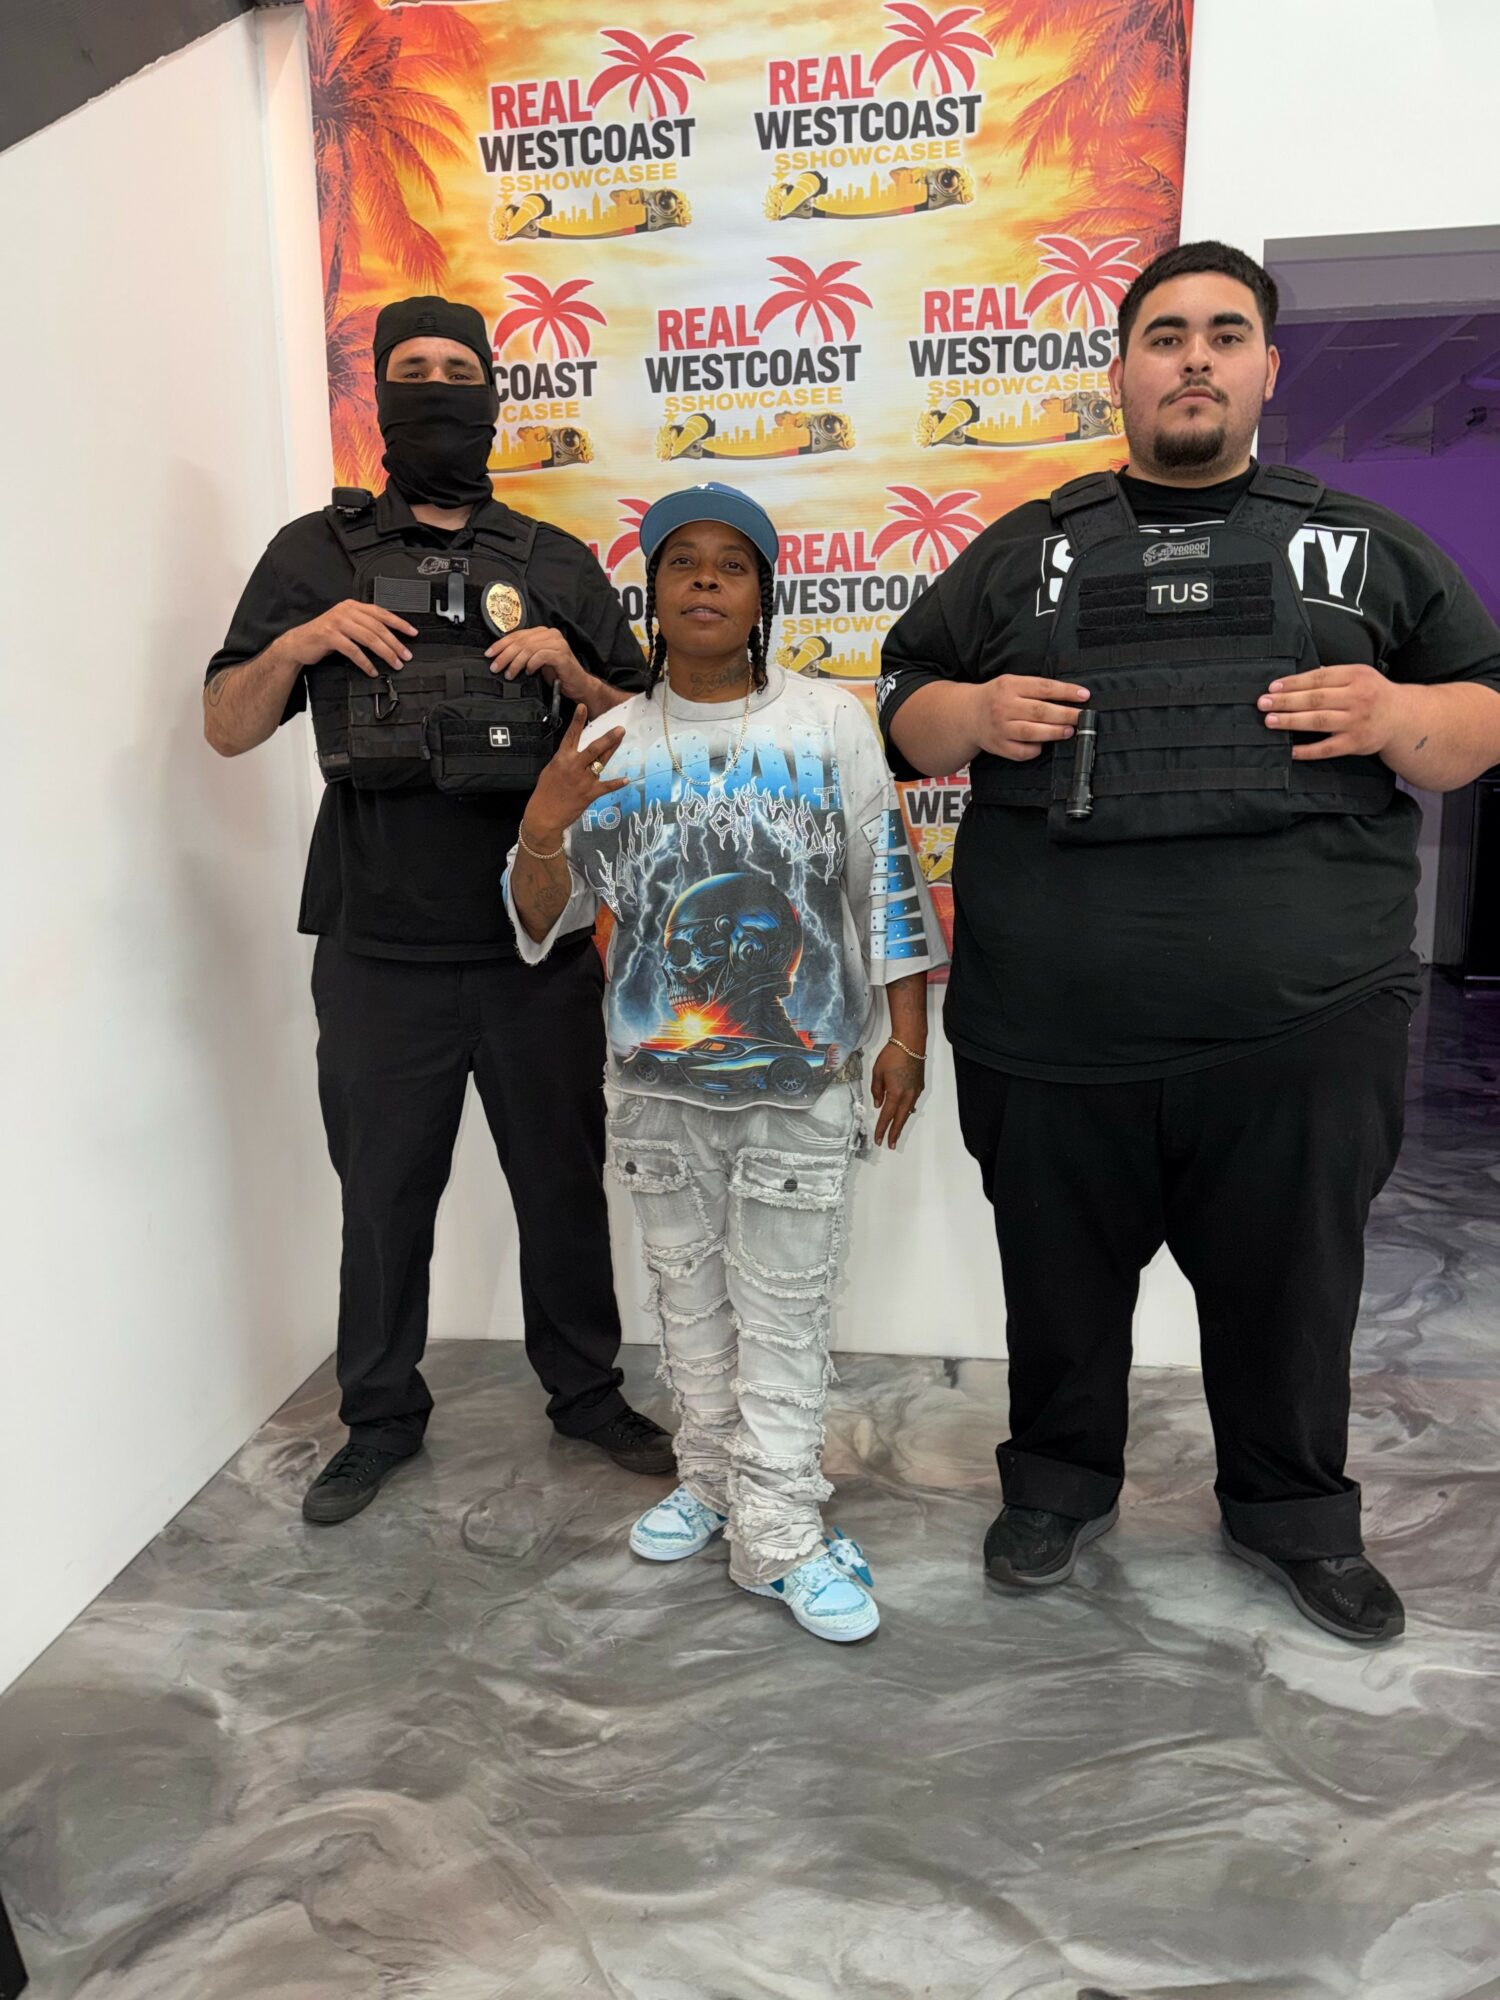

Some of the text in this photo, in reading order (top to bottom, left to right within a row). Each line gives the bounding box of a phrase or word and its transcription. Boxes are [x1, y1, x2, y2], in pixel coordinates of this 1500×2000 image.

[769, 54, 875, 105] REAL
[491, 79, 593, 130] REAL
[754, 95, 982, 150] WESTCOAST
[480, 118, 696, 172] WESTCOAST
[774, 140, 961, 171] SSHOWCASEE
[499, 162, 677, 193] SSHOWCASEE
[658, 305, 759, 351] REAL
[923, 287, 1028, 334] REAL
[493, 361, 597, 403] COAST
[645, 345, 862, 393] WESTCOAST
[502, 401, 580, 423] CASEE
[663, 387, 843, 414] SSHOWCASEE
[777, 532, 876, 575] REAL
[772, 575, 929, 615] WESTCOA
[1150, 582, 1209, 605] TUS
[782, 615, 893, 635] SSHOWC
